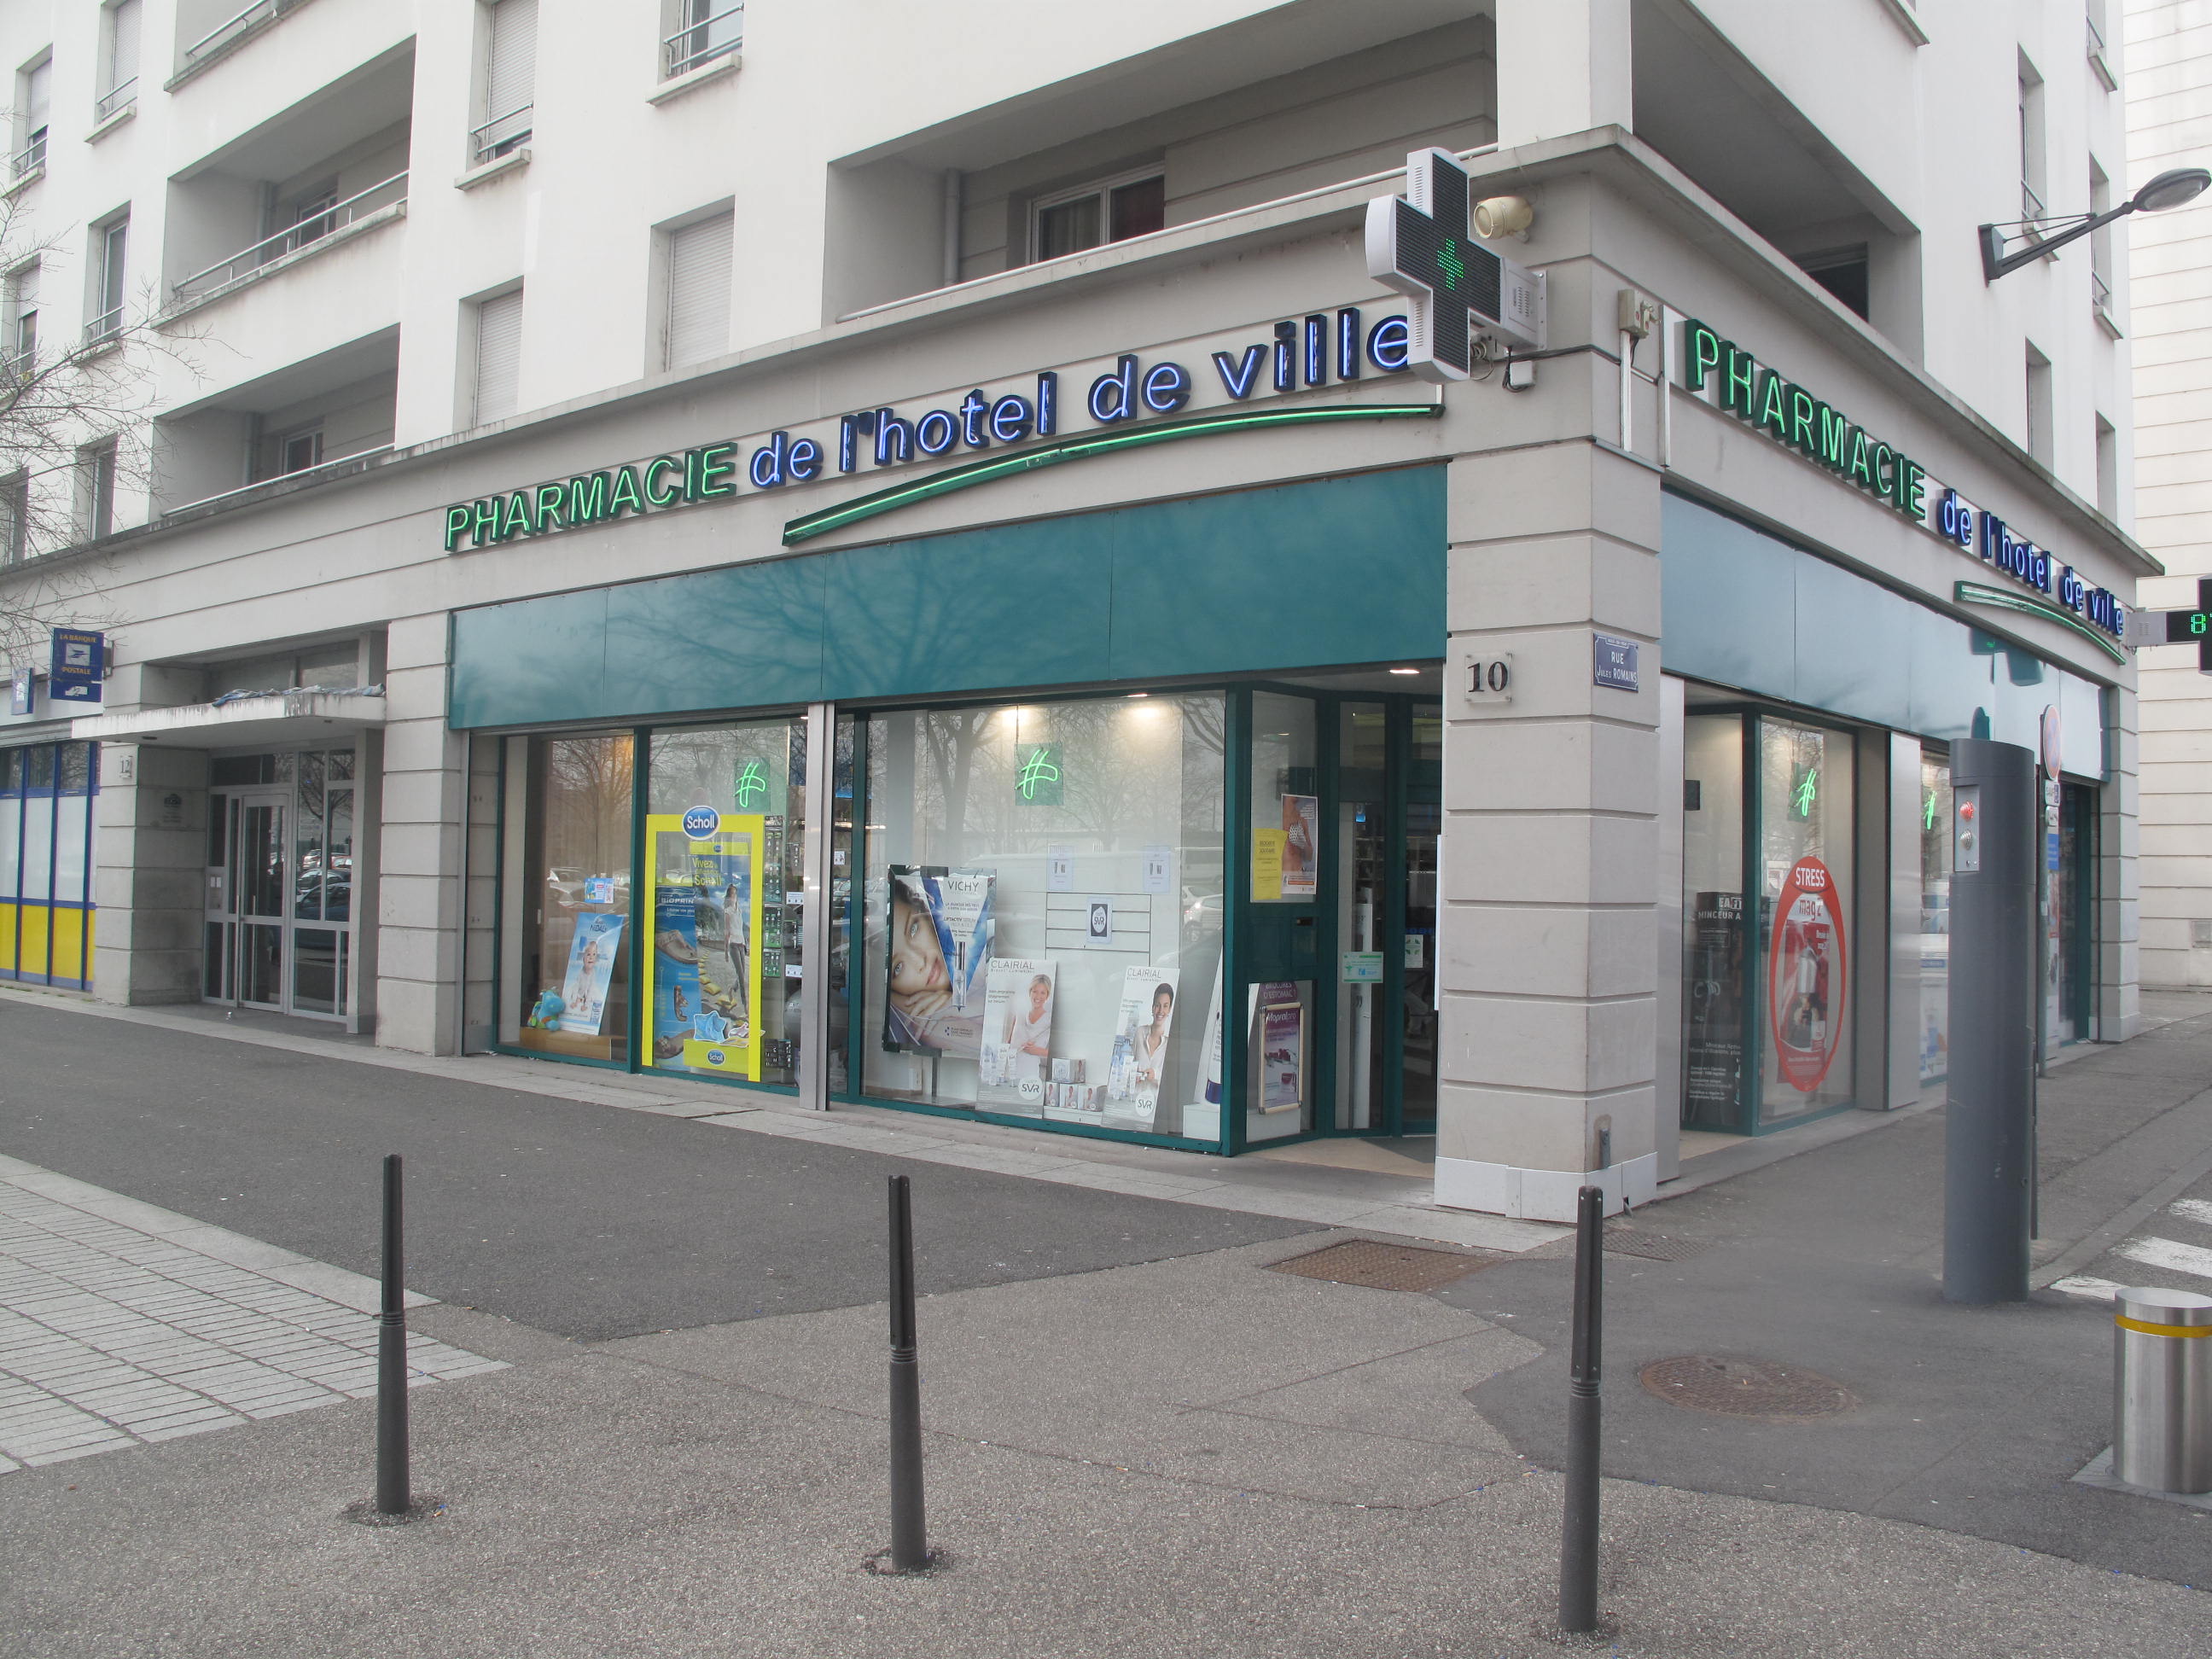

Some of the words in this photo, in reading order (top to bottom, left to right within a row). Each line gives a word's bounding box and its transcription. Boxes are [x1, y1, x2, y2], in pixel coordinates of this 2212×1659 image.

[445, 442, 737, 551] PHARMACIE
[750, 431, 824, 489] de
[839, 371, 1057, 474] l'hotel
[1087, 353, 1191, 425] de
[1211, 306, 1408, 401] ville
[1685, 318, 1925, 521] PHARMACIE
[1936, 488, 1972, 546] de
[1979, 510, 2052, 594] l'hotel
[2058, 566, 2084, 612] de
[2087, 587, 2124, 636] ville
[1611, 651, 1625, 665] RUE
[1467, 661, 1509, 693] 10
[1613, 667, 1638, 684] ROMAINS
[120, 759, 132, 774] 12
[686, 814, 716, 830] Scholl
[1796, 867, 1825, 888] STRESS
[947, 880, 980, 893] VICHY
[1093, 917, 1105, 926] SVR
[991, 960, 1035, 970] CLAIRIAL
[1126, 967, 1161, 979] CLAIRIAL
[707, 1052, 724, 1062] Scholl
[1022, 1083, 1040, 1094] SVR
[1138, 1097, 1153, 1110] SVR
